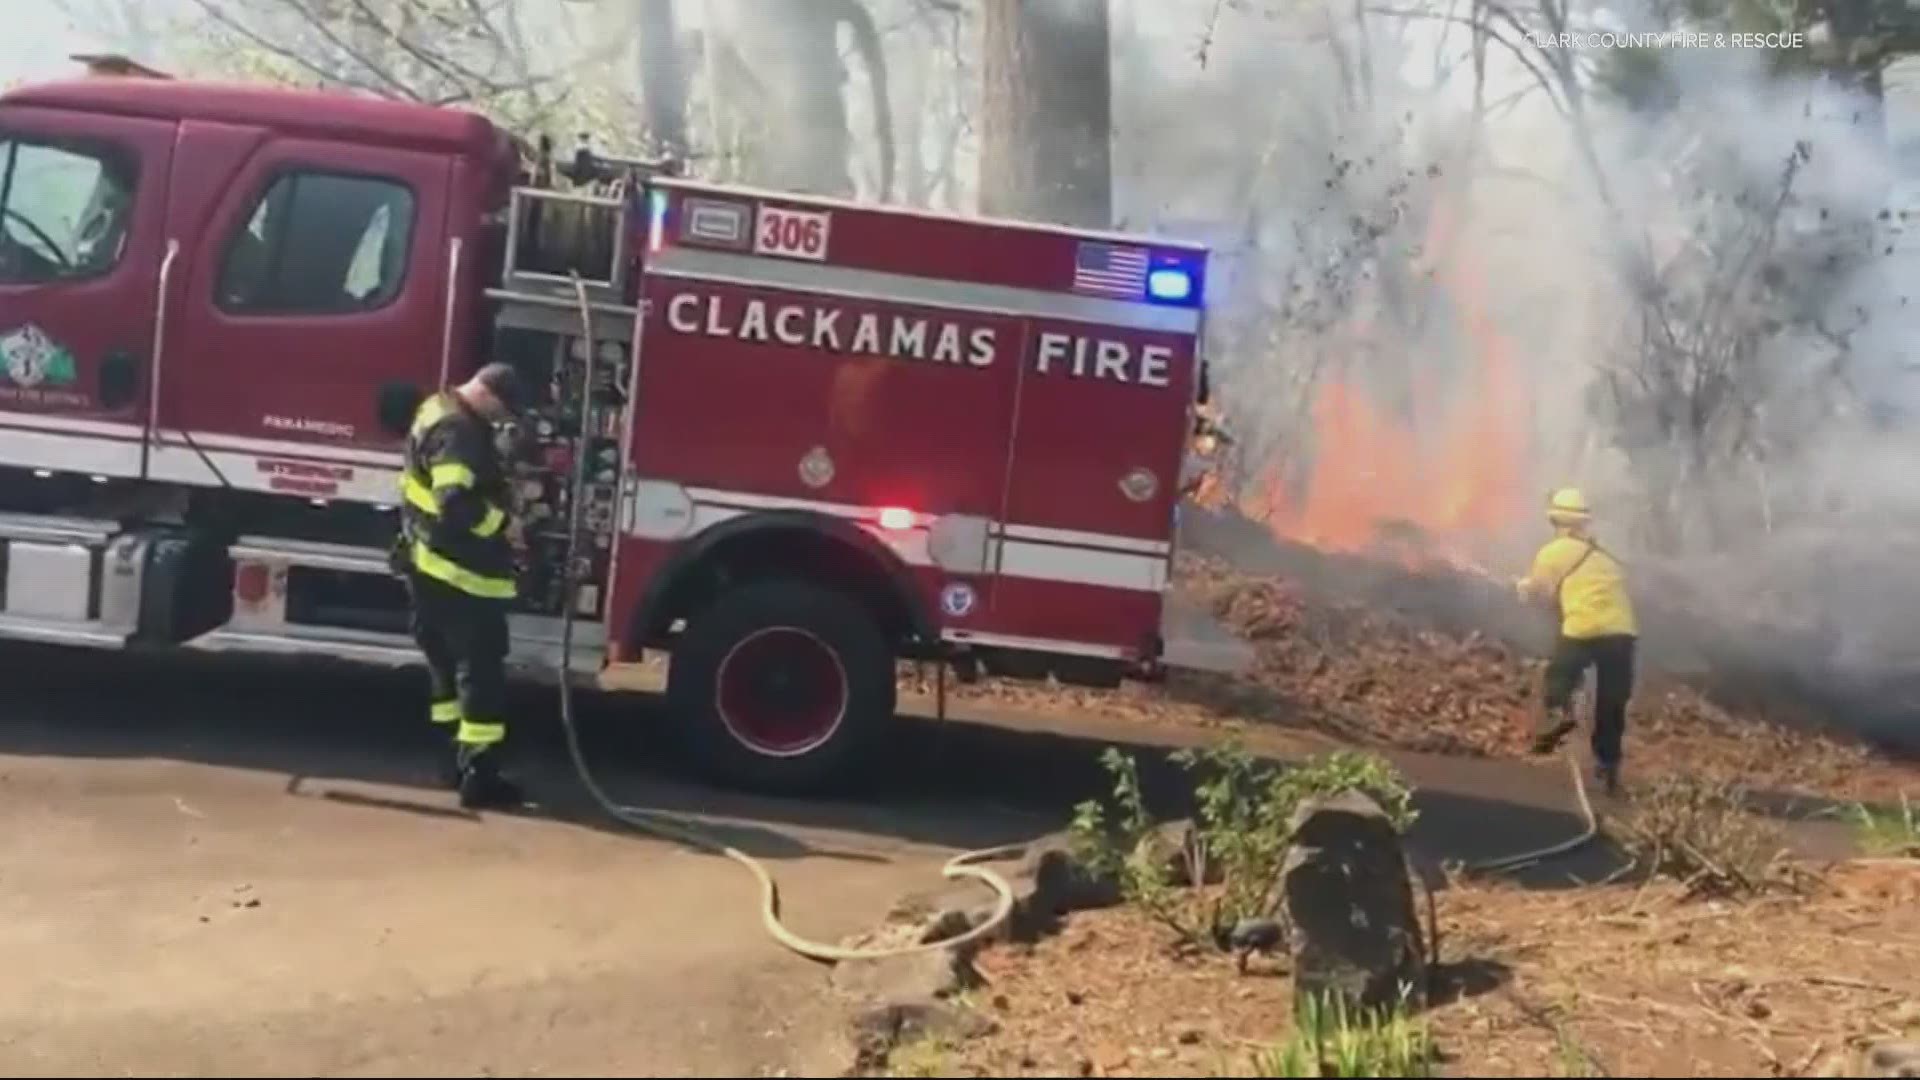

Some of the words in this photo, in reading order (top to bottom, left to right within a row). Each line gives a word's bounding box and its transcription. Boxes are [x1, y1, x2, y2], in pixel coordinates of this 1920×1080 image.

[763, 204, 820, 253] 306
[667, 294, 996, 366] CLACKAMAS
[1036, 333, 1172, 387] FIRE
